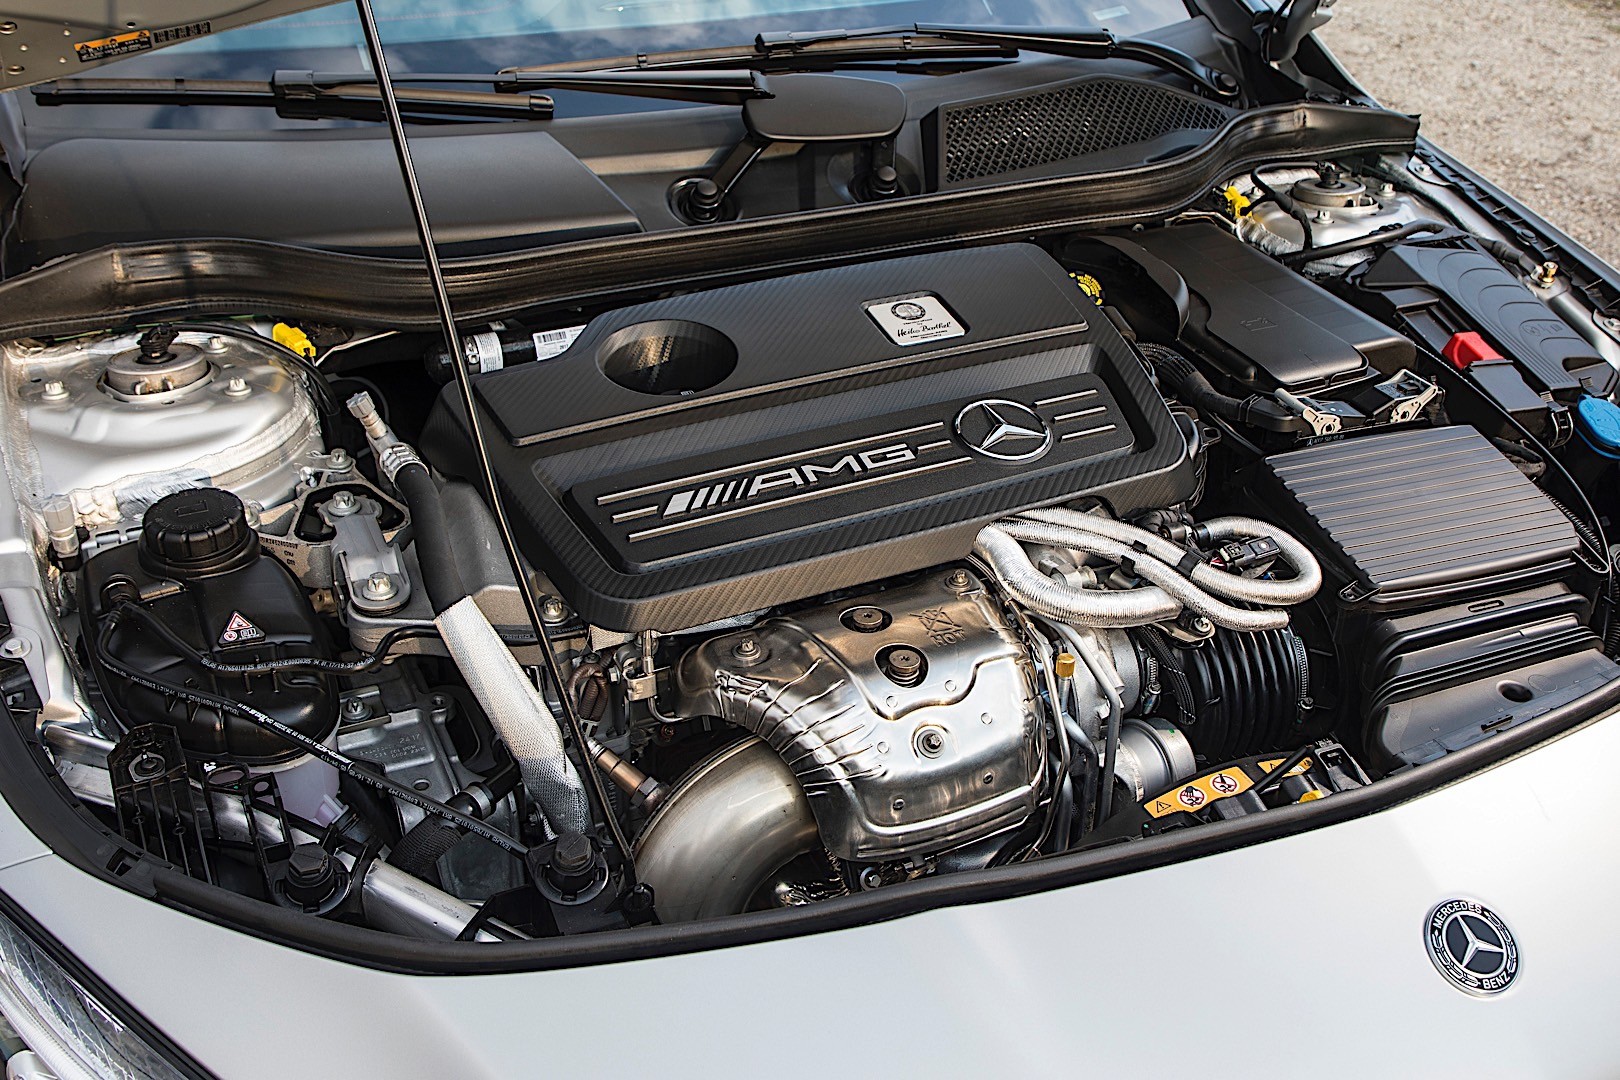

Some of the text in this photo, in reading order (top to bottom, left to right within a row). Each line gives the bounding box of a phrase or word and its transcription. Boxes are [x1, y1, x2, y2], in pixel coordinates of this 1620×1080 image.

[748, 443, 918, 498] AMG
[929, 629, 966, 648] HOT
[1432, 901, 1482, 929] MERCEDES
[1482, 971, 1511, 989] BENZ
